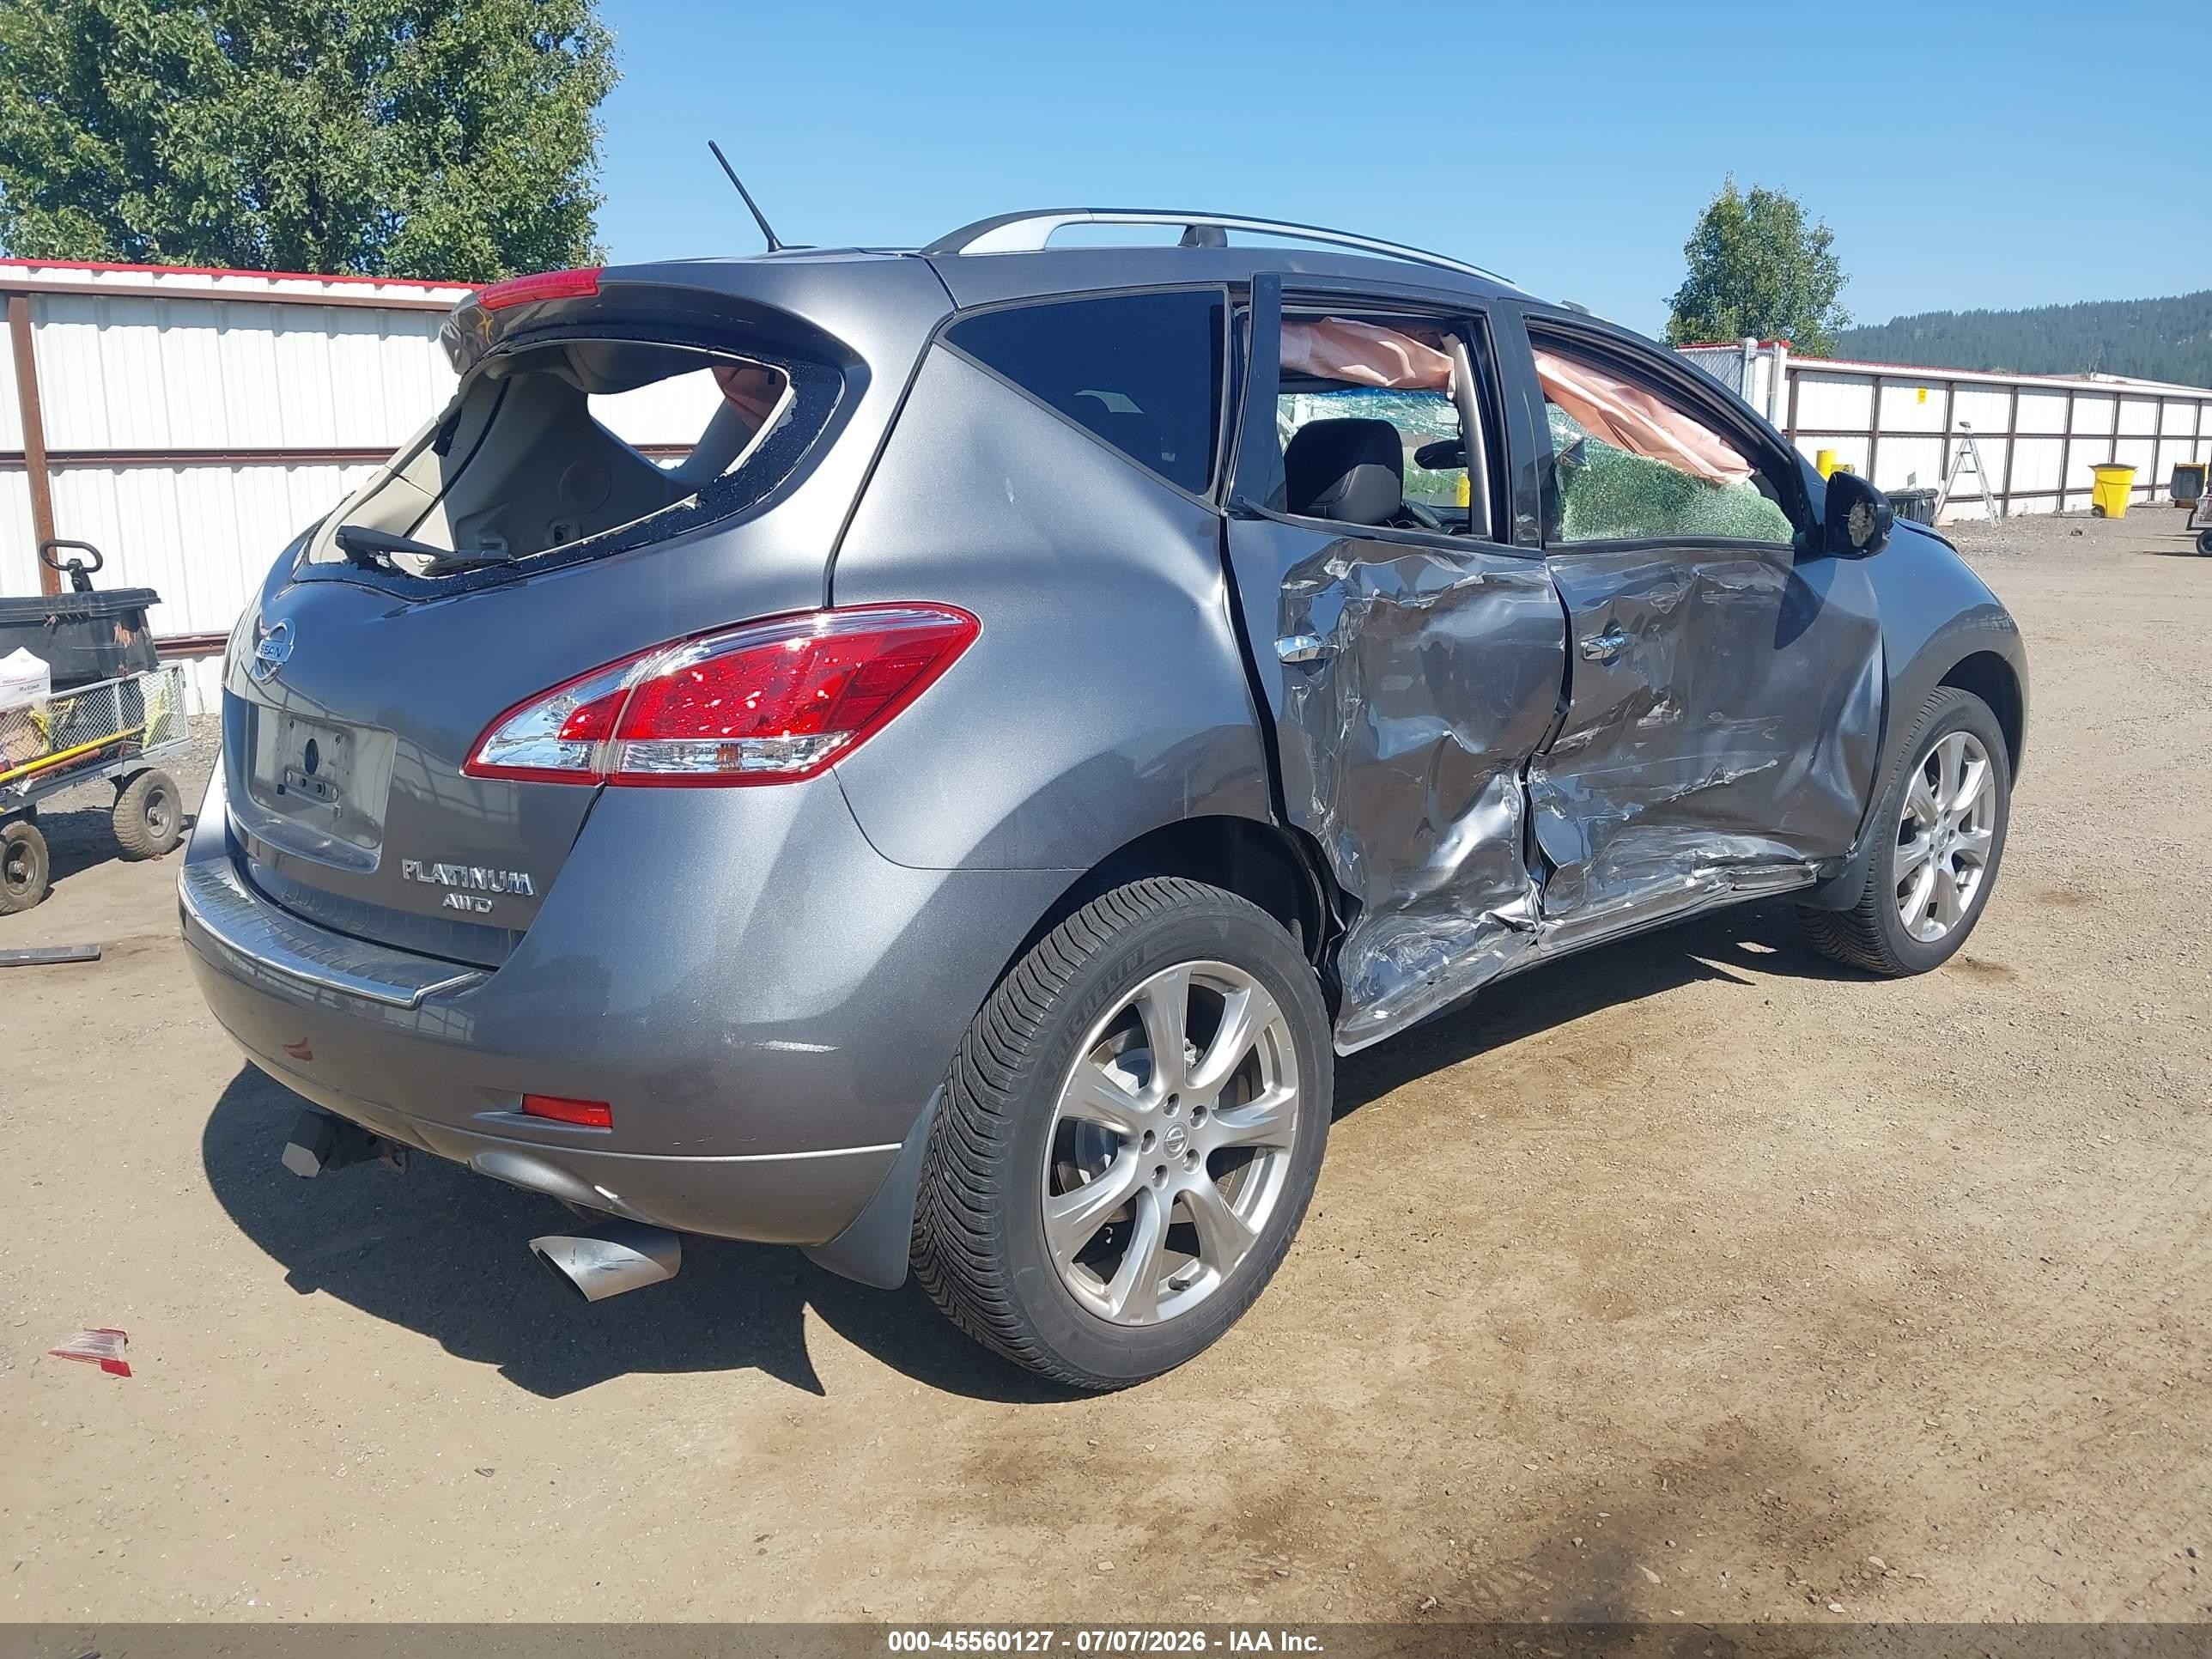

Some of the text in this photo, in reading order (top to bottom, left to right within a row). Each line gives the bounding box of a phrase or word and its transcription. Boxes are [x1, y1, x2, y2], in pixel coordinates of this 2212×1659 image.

[402, 859, 534, 896] PLATINUM
[442, 892, 494, 914] AWD
[1048, 947, 1141, 1073] MICHELIN
